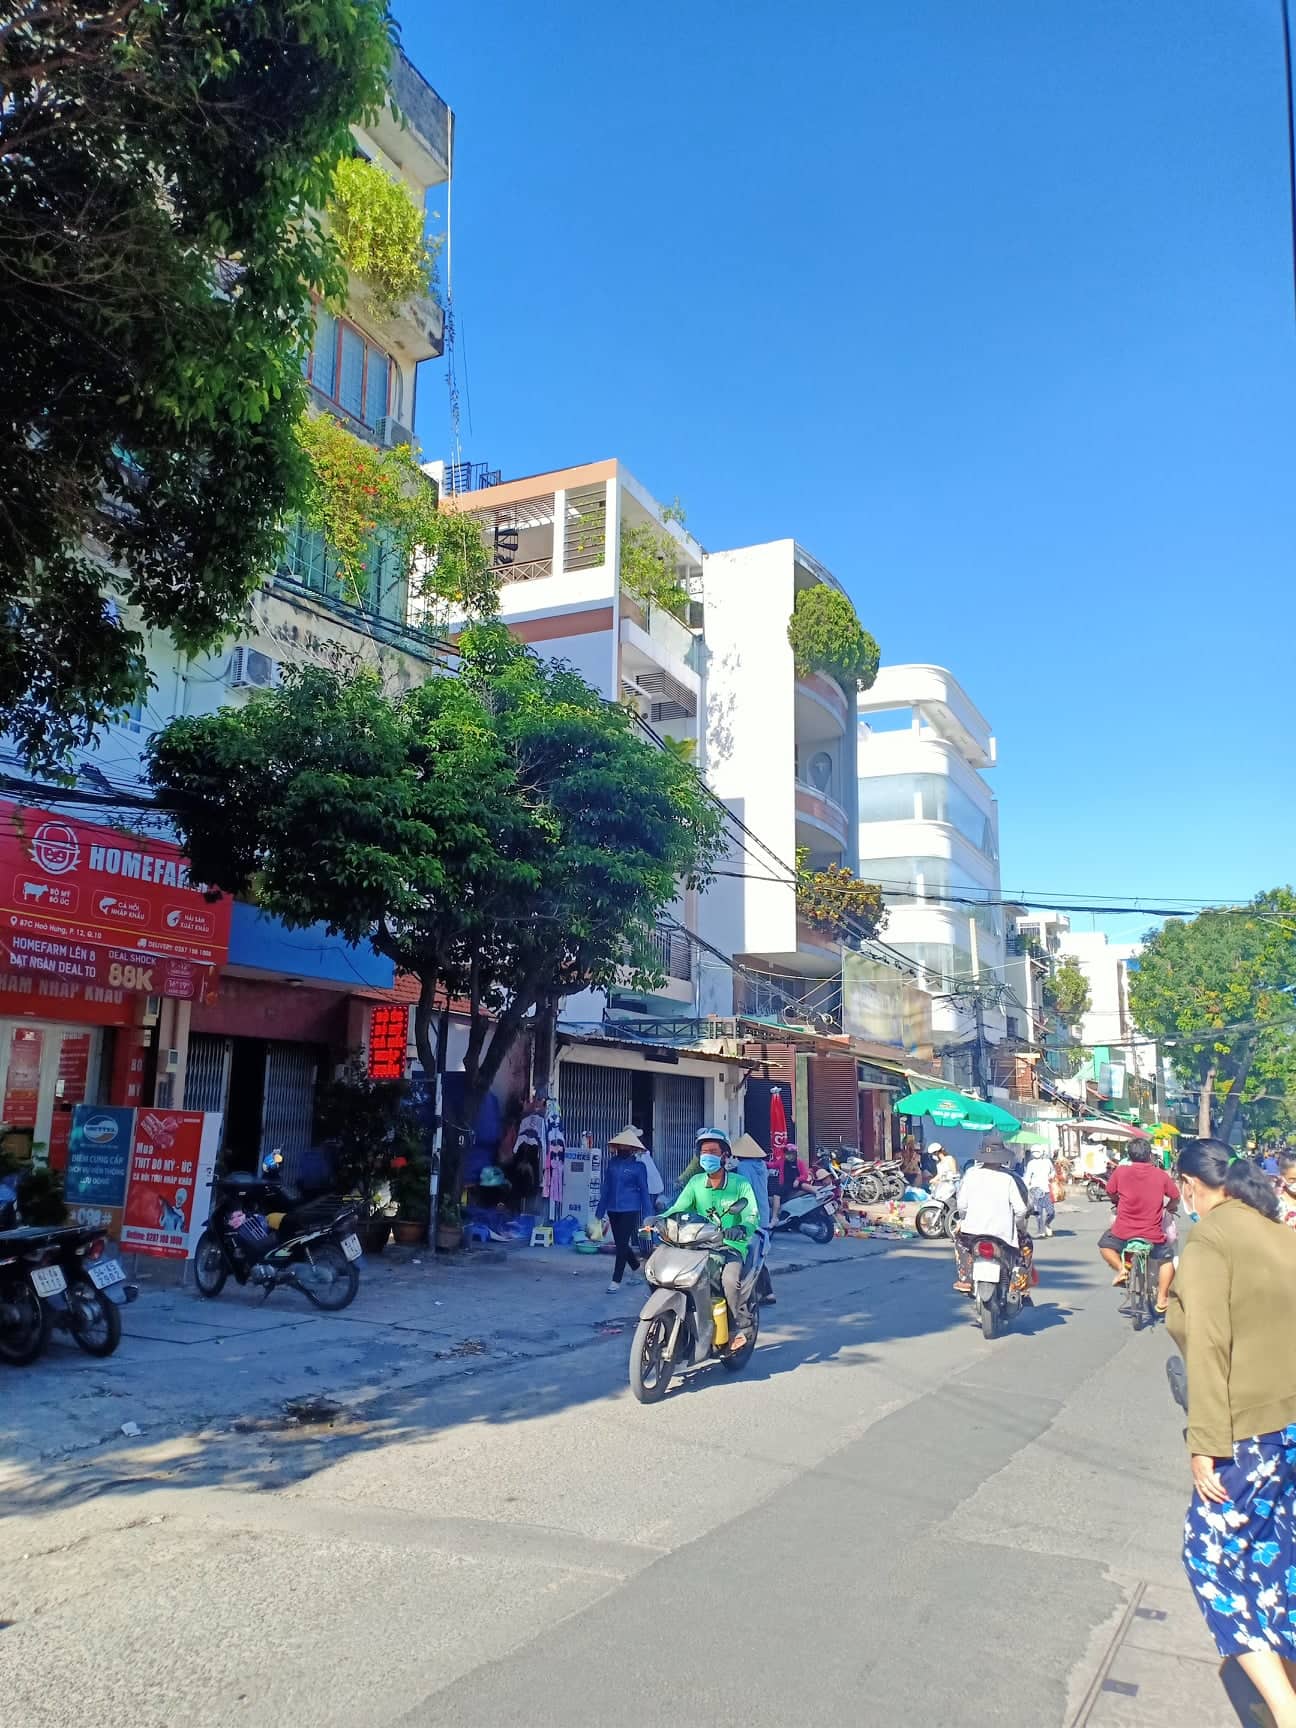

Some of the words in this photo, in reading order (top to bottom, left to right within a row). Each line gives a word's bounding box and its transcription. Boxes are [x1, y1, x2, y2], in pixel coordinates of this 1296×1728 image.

[12, 936, 67, 957] HOMEFARM
[69, 945, 87, 961] LÊN
[108, 950, 129, 961] DEAL
[130, 954, 157, 965] SHOCK
[58, 961, 83, 976] DEAL
[108, 963, 153, 992] 88K
[136, 1142, 154, 1154] Mua
